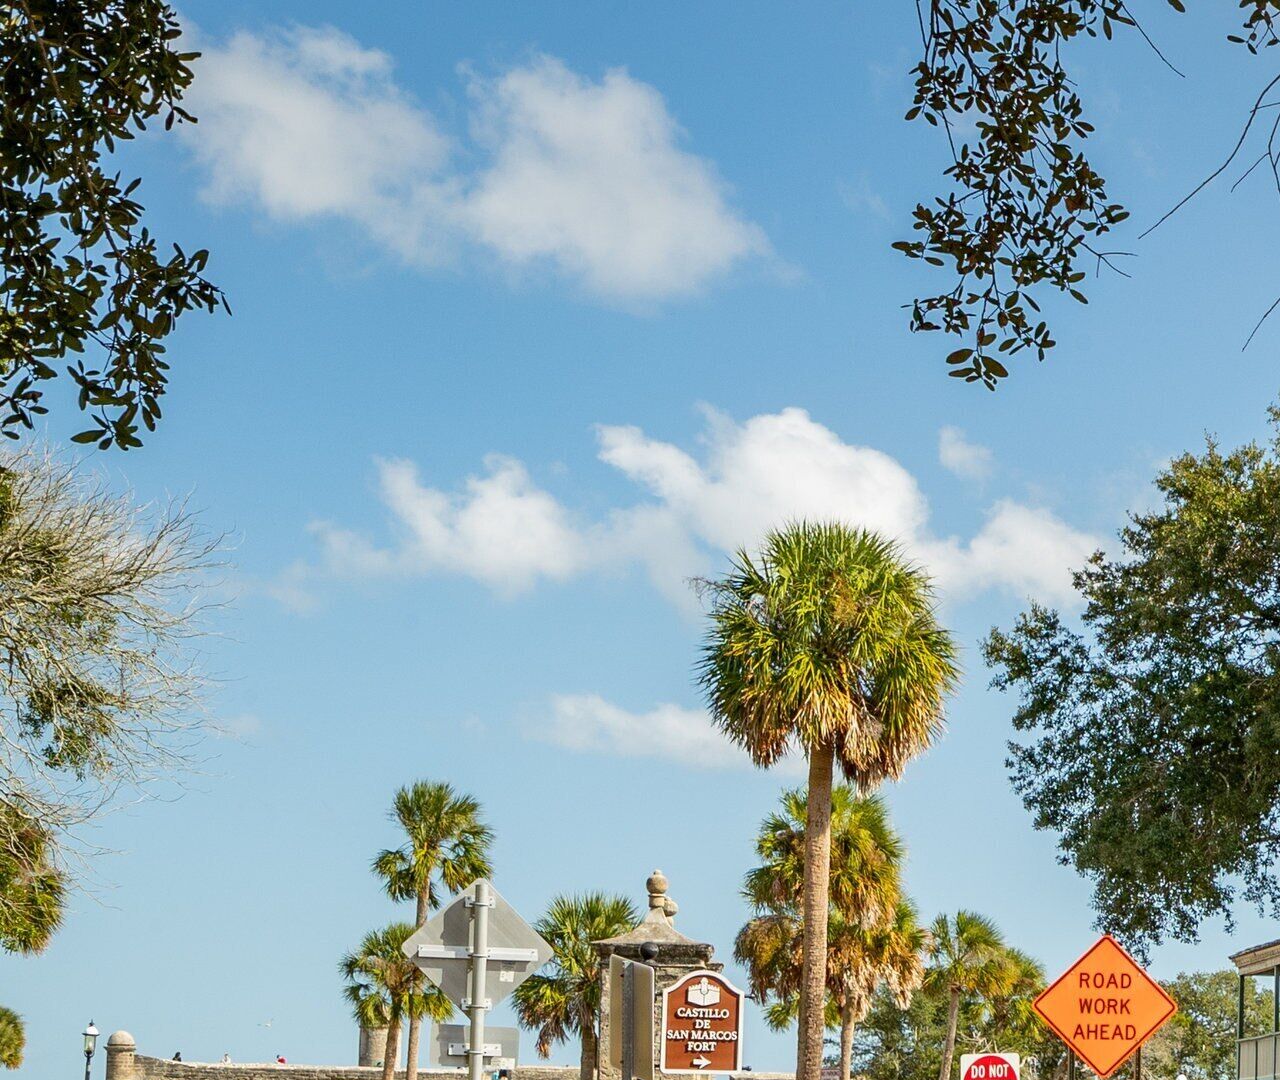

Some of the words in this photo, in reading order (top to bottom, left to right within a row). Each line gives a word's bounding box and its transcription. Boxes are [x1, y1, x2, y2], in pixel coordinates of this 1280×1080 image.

[1079, 972, 1132, 989] ROAD
[677, 1007, 730, 1018] CASTILLO
[1079, 998, 1131, 1015] WORK
[695, 1019, 711, 1029] DE
[667, 1030, 689, 1040] SAN
[691, 1031, 738, 1040] MARCOS
[1072, 1023, 1137, 1040] AHEAD
[687, 1041, 717, 1052] FORT
[970, 1065, 985, 1079] DO
[989, 1063, 1009, 1078] NOT
